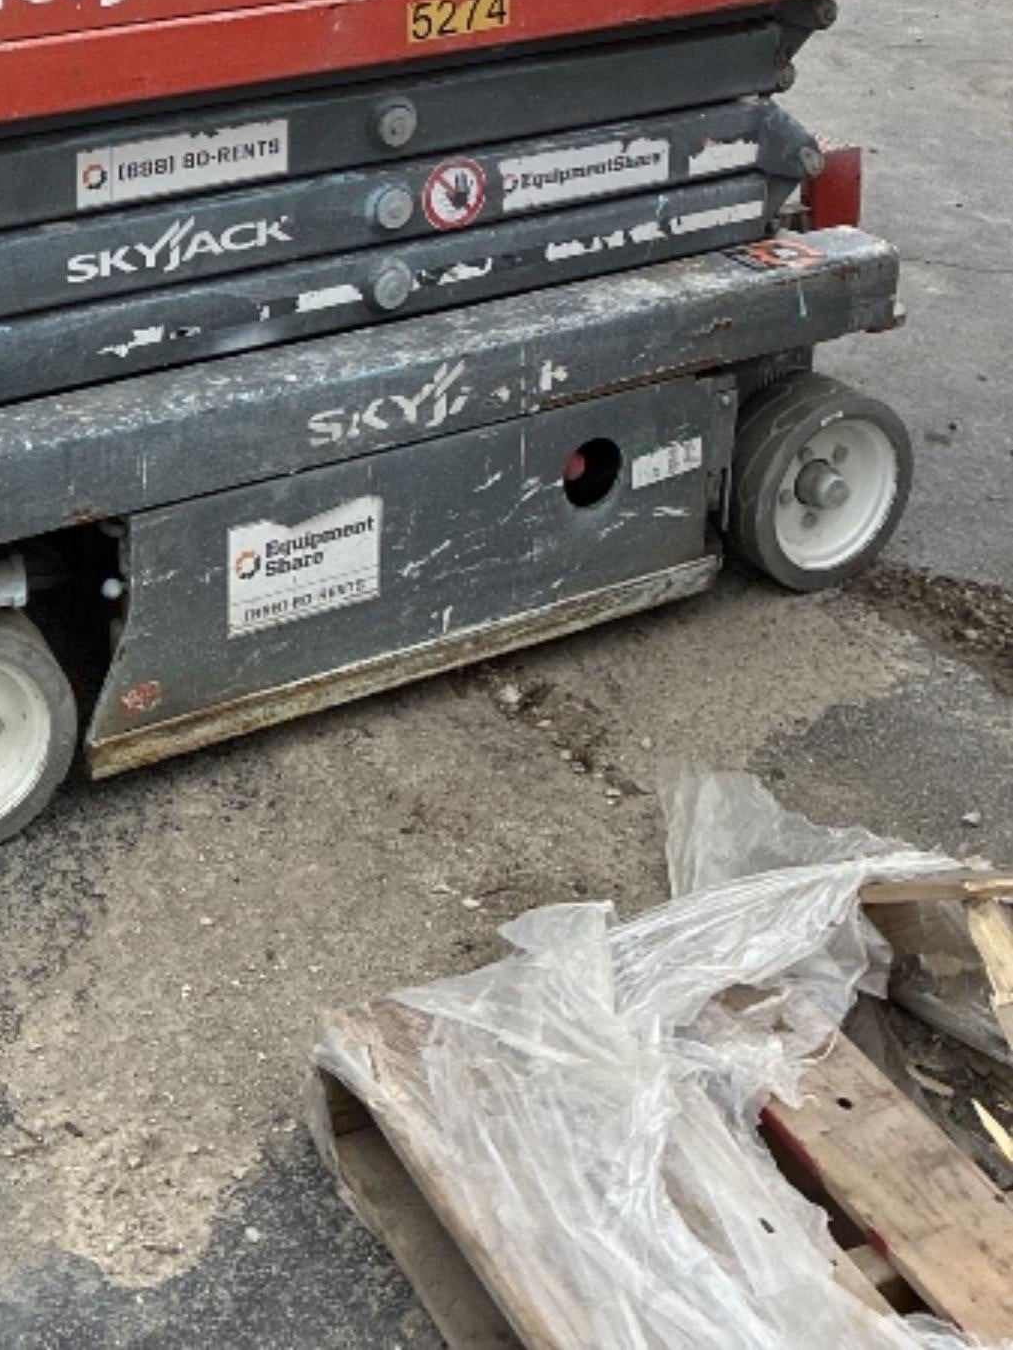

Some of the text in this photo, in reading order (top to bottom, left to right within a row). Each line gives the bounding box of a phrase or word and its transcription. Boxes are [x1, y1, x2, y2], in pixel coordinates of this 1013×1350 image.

[67, 215, 293, 284] SKYJACK
[265, 515, 375, 558] Equipment
[265, 551, 324, 577] Share
